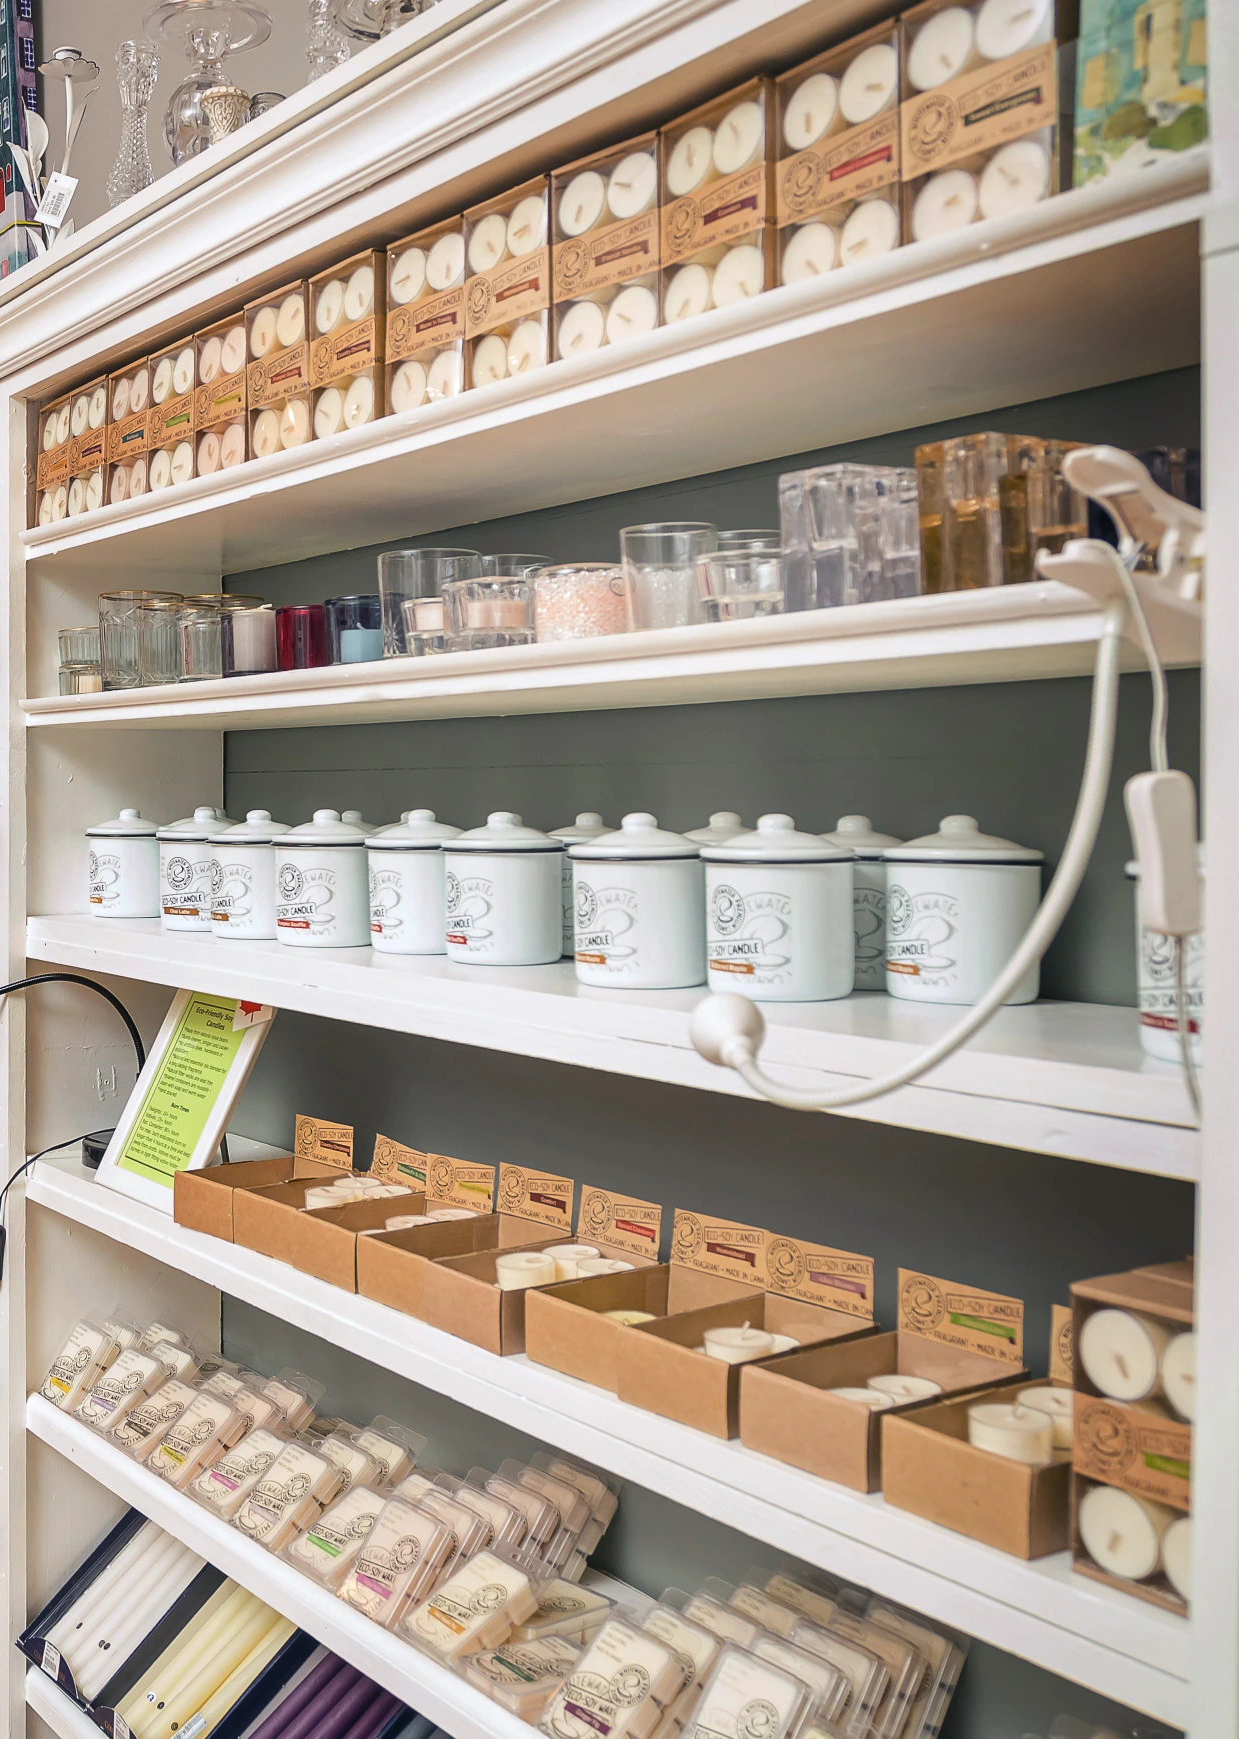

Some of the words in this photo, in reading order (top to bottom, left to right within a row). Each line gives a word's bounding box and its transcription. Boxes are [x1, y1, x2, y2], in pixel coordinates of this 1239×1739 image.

[625, 219, 653, 239] CANDLE
[519, 258, 543, 276] CANDLE
[617, 266, 634, 277] MADE
[415, 306, 437, 322] ECO-SOY
[439, 293, 462, 310] CANDLE
[354, 324, 374, 341] CANDLE
[431, 334, 444, 343] MADE
[180, 894, 202, 903] CANDLE
[291, 904, 314, 914] CANDLE
[451, 918, 470, 928] CANDLE
[585, 934, 610, 947] CANDLE
[728, 942, 759, 954] CANDLE
[898, 943, 926, 957] CANDLE
[728, 964, 748, 973] Maple
[195, 1006, 224, 1021] Eco-Friendly
[224, 1013, 235, 1023] Soy
[206, 1019, 225, 1031] Candles
[319, 1130, 337, 1139] ECO-SOY
[337, 1131, 353, 1140] CANDLE
[312, 1153, 329, 1163] FRAGRANT
[331, 1157, 340, 1165] MADE
[398, 1151, 416, 1163] ECO-SOY
[456, 1170, 475, 1180] ECO-SOY
[476, 1171, 495, 1181] CANDLE
[529, 1181, 551, 1192] ECO-SOY
[552, 1183, 571, 1194] CANDLE
[448, 1196, 468, 1207] FRAGRANT
[471, 1201, 481, 1209] MADE
[540, 1196, 557, 1206] Comfort
[518, 1207, 541, 1218] FRAGRANT
[545, 1213, 557, 1224] MADE
[615, 1208, 638, 1219] ECO-SOY
[639, 1210, 661, 1222] CANDLE
[603, 1234, 627, 1247] FRAGRANT
[631, 1242, 644, 1253] MADE
[706, 1231, 733, 1242] ECO-SOY
[736, 1233, 761, 1244] CANDLE
[693, 1260, 720, 1273] FRAGRANT
[725, 1267, 741, 1278] MADE
[808, 1258, 839, 1272] ECO-SOY
[842, 1261, 871, 1275] CANDLE
[796, 1288, 827, 1303] FRAGRANT
[833, 1299, 851, 1311] MADE
[949, 1299, 985, 1314] ECO-SOY
[988, 1302, 1022, 1319] CANDLE
[934, 1330, 970, 1349] FRAGRANT
[976, 1342, 997, 1357] MADE
[164, 1435, 180, 1449] ECO-SOY
[179, 1442, 190, 1453] WAX
[214, 1463, 233, 1478] ECO-SOY
[233, 1470, 245, 1481] WAX
[253, 1490, 273, 1508] ECO-SOY
[272, 1499, 285, 1512] WAX
[312, 1525, 335, 1541] ECO-SOY
[334, 1534, 346, 1546] WAX
[359, 1560, 381, 1579] ECO-SOY
[381, 1570, 395, 1583] WAX
[432, 1598, 458, 1616] ECO-SOY
[457, 1609, 471, 1621] WAX
[567, 1689, 597, 1709] ECO-SOY
[598, 1704, 614, 1717] WAX
